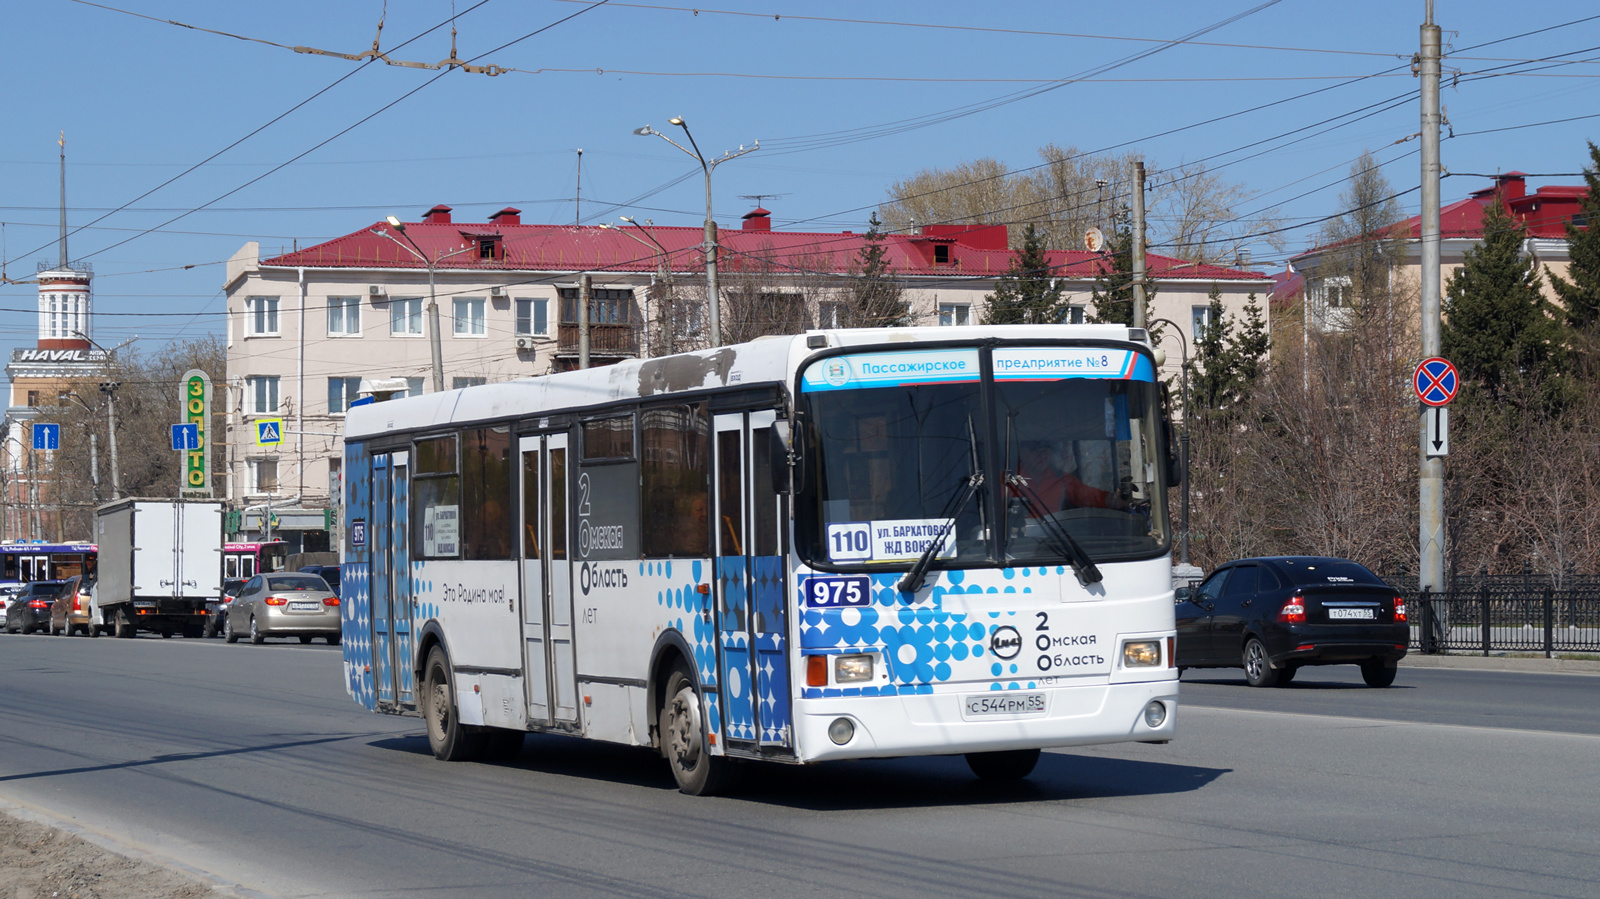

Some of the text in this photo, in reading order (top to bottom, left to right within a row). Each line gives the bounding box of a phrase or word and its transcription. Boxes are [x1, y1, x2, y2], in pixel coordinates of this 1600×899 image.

[20, 349, 86, 361] HAVAL
[861, 359, 966, 375] Пассажирское
[996, 357, 1083, 370] предприятие
[578, 472, 591, 516] 2
[354, 525, 364, 541] 975
[579, 519, 623, 558] Омская
[831, 530, 868, 552] 110
[877, 528, 892, 539] ул.
[884, 540, 903, 555] ЖД
[580, 561, 628, 596] Область
[442, 583, 505, 605] Это Родина моя!
[813, 581, 861, 604] 975
[582, 607, 598, 624] лет
[1035, 611, 1049, 631] 2
[1035, 634, 1097, 652] Омская
[1036, 654, 1105, 672] Область
[1037, 676, 1060, 685] лет
[1028, 696, 1041, 707] 55
